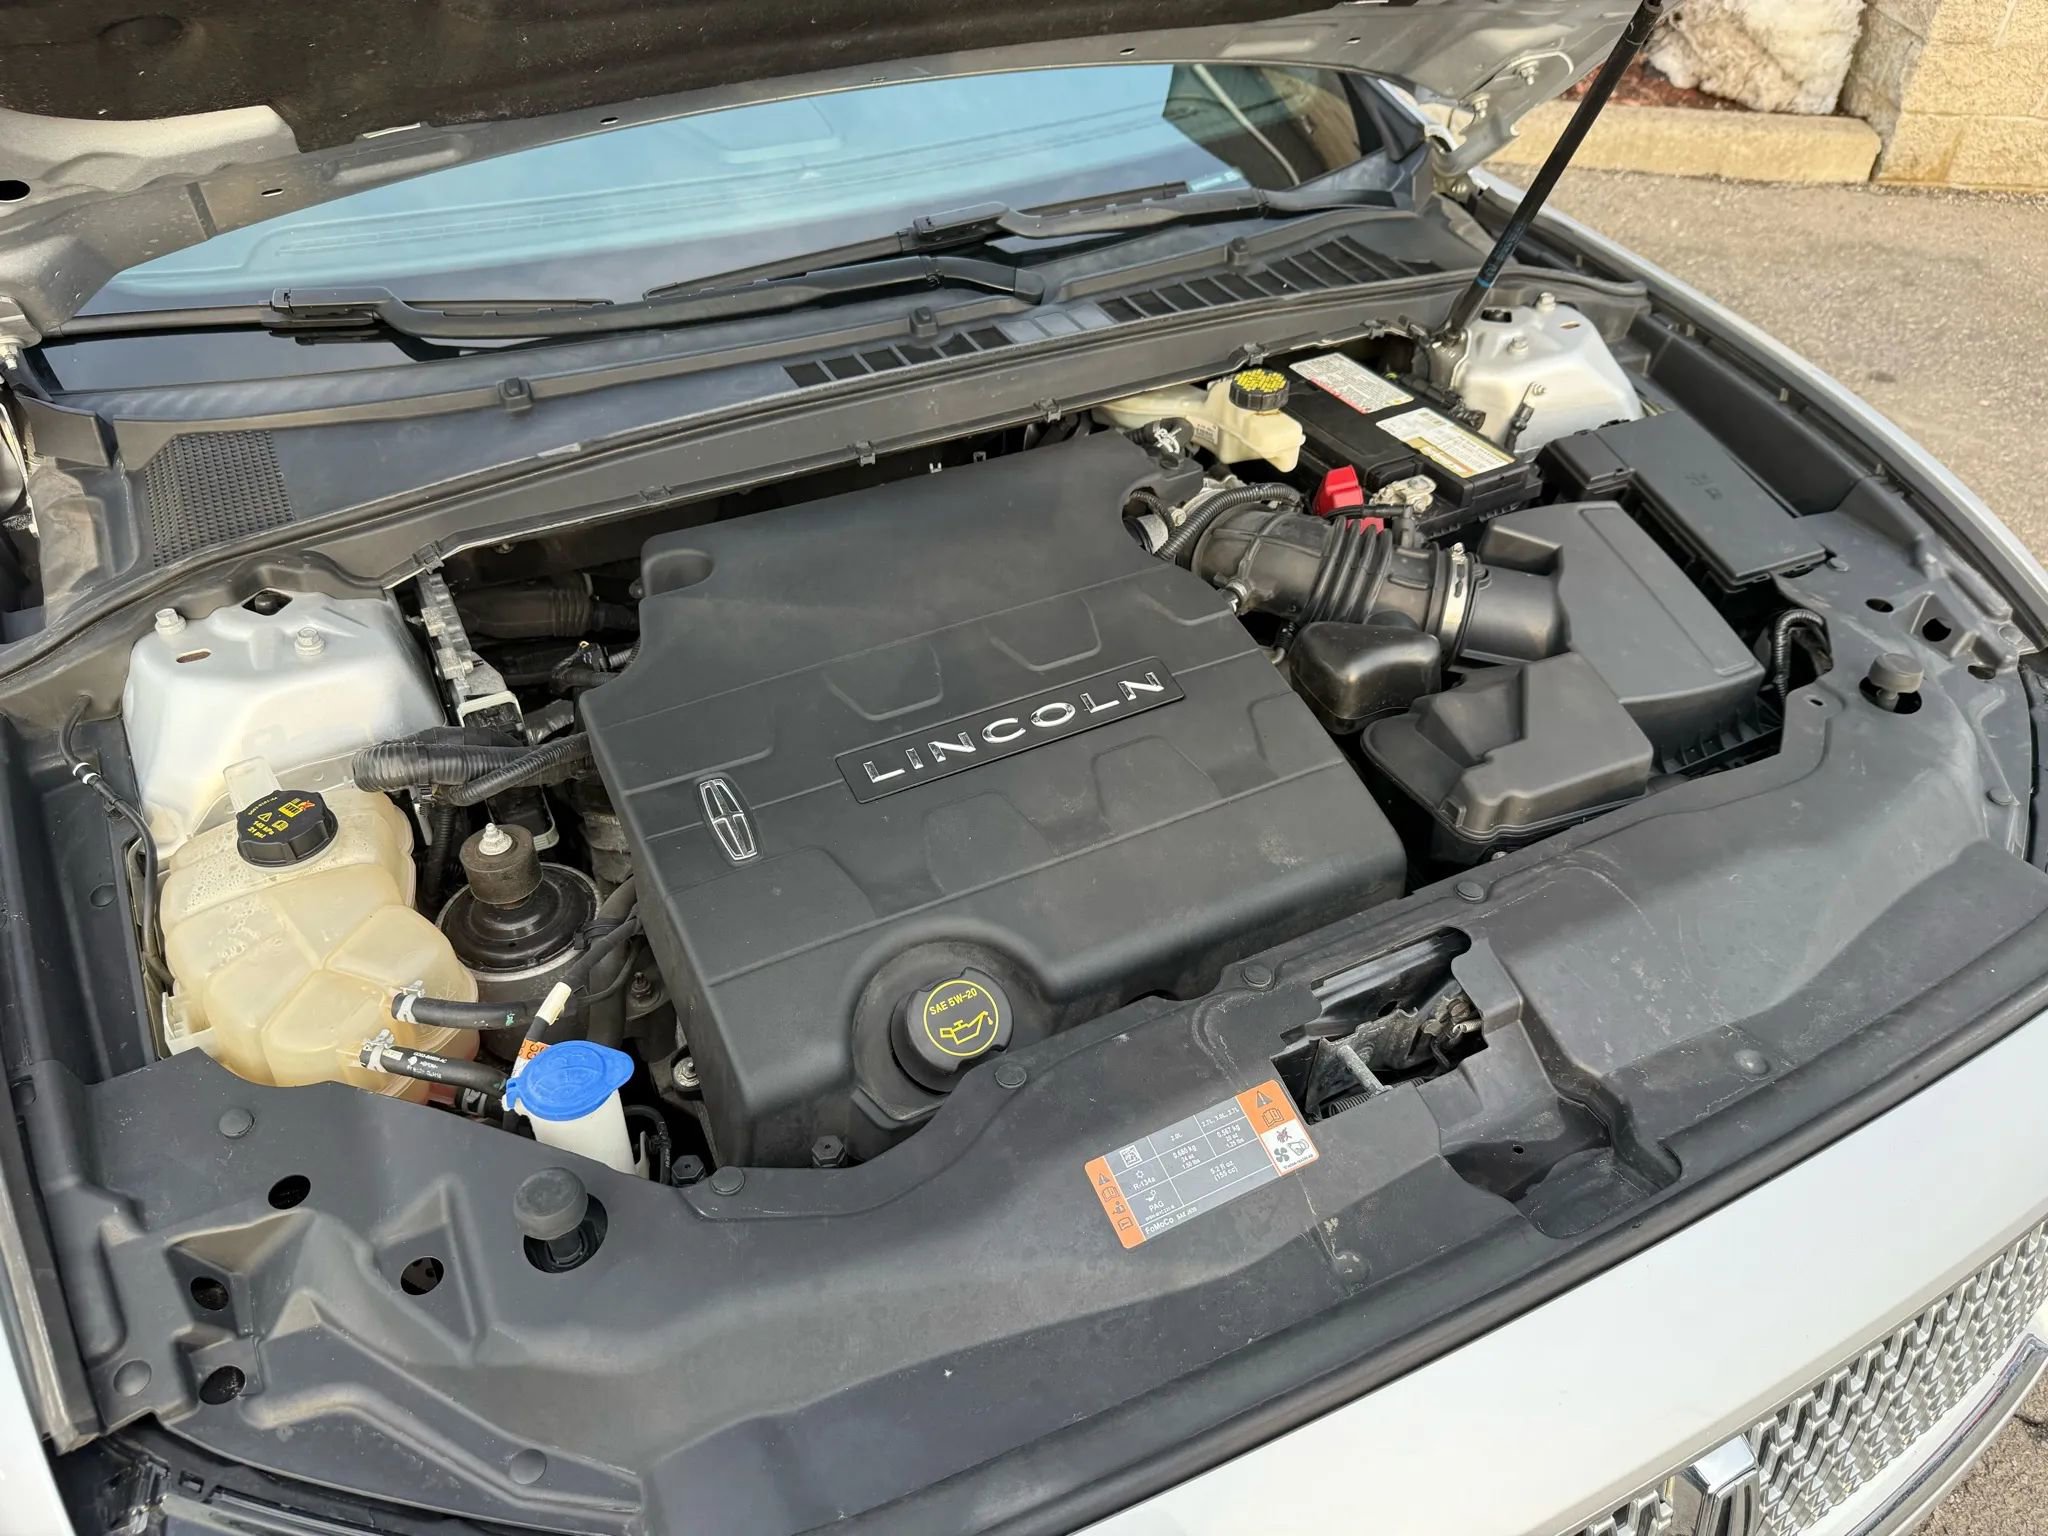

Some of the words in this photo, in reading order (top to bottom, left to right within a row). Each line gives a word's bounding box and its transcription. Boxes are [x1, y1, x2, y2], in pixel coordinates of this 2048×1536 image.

[863, 671, 1165, 784] LINCOLN
[929, 1001, 948, 1015] SAE
[947, 987, 977, 1007] 5W-20
[1231, 1124, 1240, 1132] kg
[1187, 1144, 1197, 1152] kg
[1210, 1165, 1221, 1175] 5.2
[1226, 1160, 1234, 1168] oz
[1214, 1169, 1227, 1182] (155
[1227, 1166, 1238, 1175] cc)
[1133, 1177, 1156, 1191] R-134a
[1148, 1201, 1164, 1212] PAG
[1145, 1217, 1174, 1234] FoMoCo
